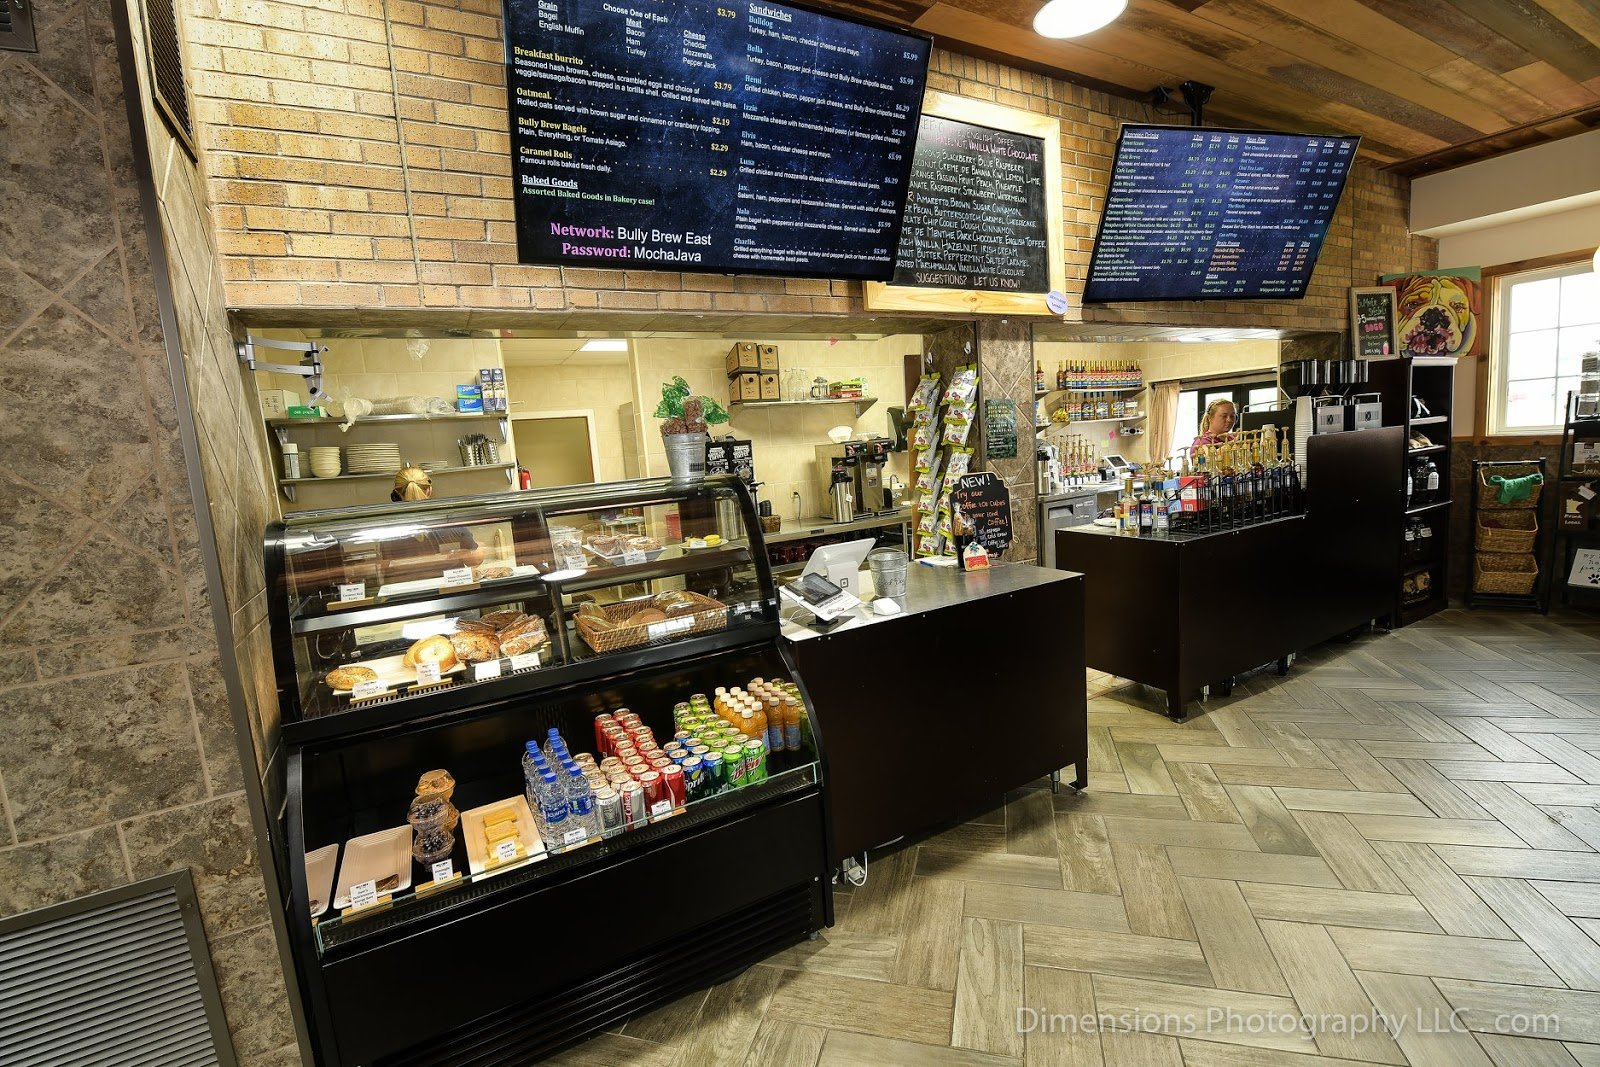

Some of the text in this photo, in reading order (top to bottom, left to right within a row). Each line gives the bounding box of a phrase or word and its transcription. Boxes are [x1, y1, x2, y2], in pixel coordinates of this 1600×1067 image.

[538, 0, 557, 12] Grain
[749, 2, 792, 21] Sandwiches
[538, 10, 557, 21] Bagel
[603, 3, 667, 23] Choose One of Each
[717, 8, 736, 19] $3.79
[626, 18, 641, 28] Meat
[748, 15, 772, 28] Bulldog
[539, 21, 584, 36] English Muffin
[626, 28, 644, 37] Bacon
[626, 37, 640, 45] Ham
[514, 46, 583, 65] Breakfast burrito
[626, 46, 646, 57] Turkey
[714, 82, 732, 90] $3.79
[518, 117, 586, 133] Bully Brew Bagels
[712, 117, 729, 126] $2.19
[518, 127, 536, 136] Plain,
[582, 136, 604, 144] Tomato
[605, 139, 626, 147] Asiago.
[520, 146, 572, 158] Caramel Rolls
[710, 143, 728, 151] $2.29
[520, 156, 545, 164] Famous
[522, 175, 577, 188] Baked Goods
[522, 187, 555, 196] Assorted
[557, 190, 579, 198] Baked
[581, 192, 602, 200] Goods
[613, 195, 636, 204] Bakery
[551, 222, 711, 245] Network: Bully Brew East
[562, 243, 702, 262] Password: MochaJava
[914, 273, 967, 285] SUGGESTIONS?
[973, 276, 987, 286] LET
[989, 277, 998, 286] US
[962, 474, 990, 489] NEW!
[955, 489, 968, 501] Try
